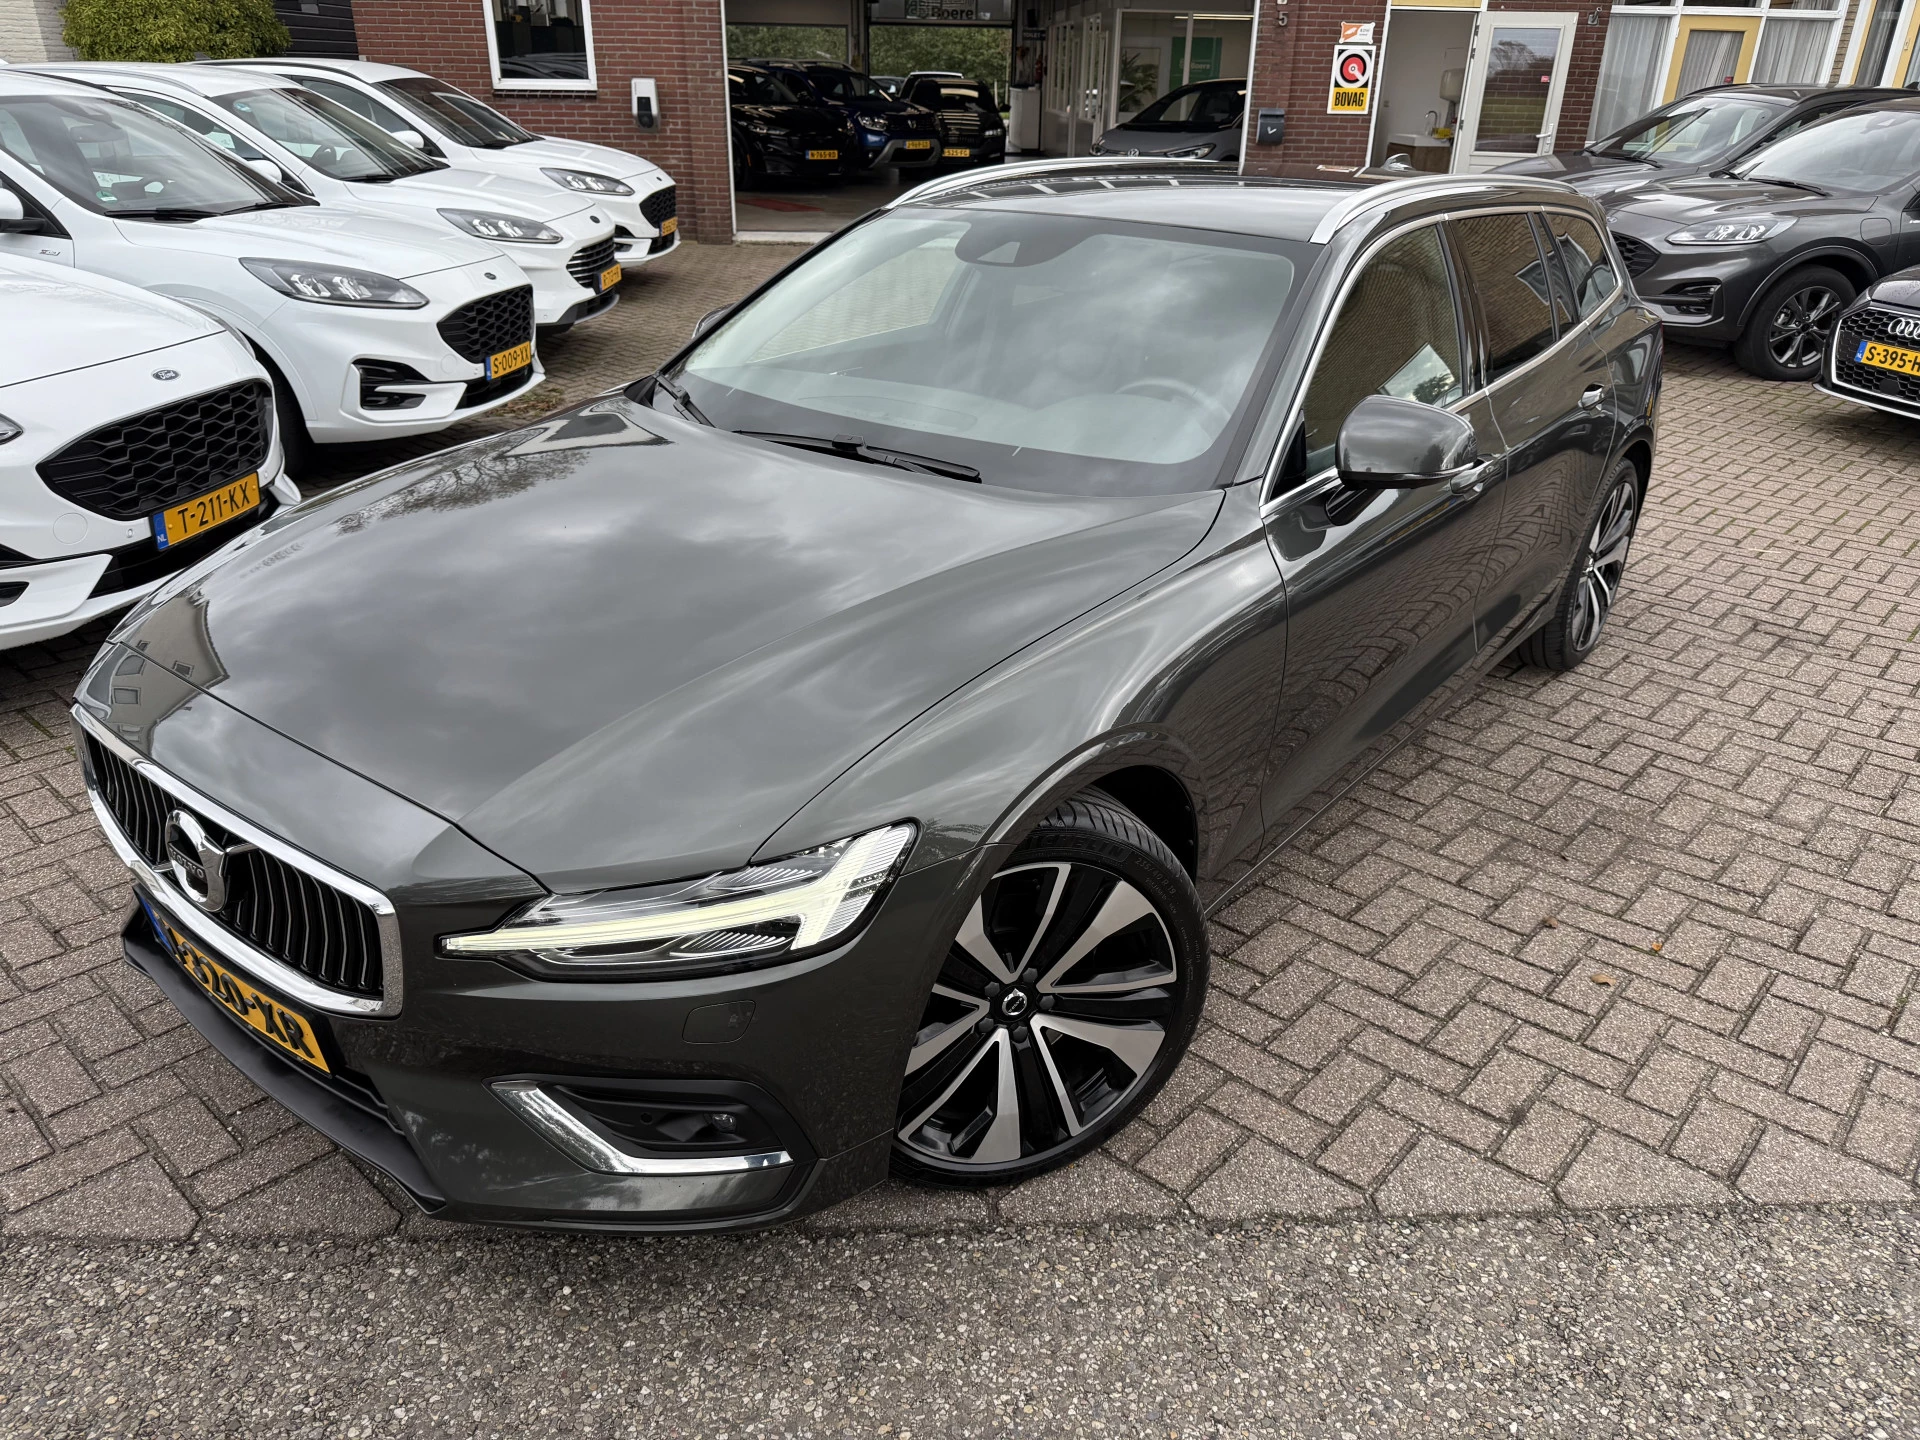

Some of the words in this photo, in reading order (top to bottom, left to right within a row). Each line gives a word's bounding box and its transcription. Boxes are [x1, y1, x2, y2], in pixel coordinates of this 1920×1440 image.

[932, 7, 974, 19] Boere
[1278, 12, 1288, 26] 5
[1334, 91, 1365, 107] BOVAG
[493, 344, 530, 375] S-009-XX
[158, 369, 176, 380] Ford
[177, 480, 251, 534] T-211-KX
[156, 534, 168, 544] NL
[169, 847, 204, 879] VOLVO
